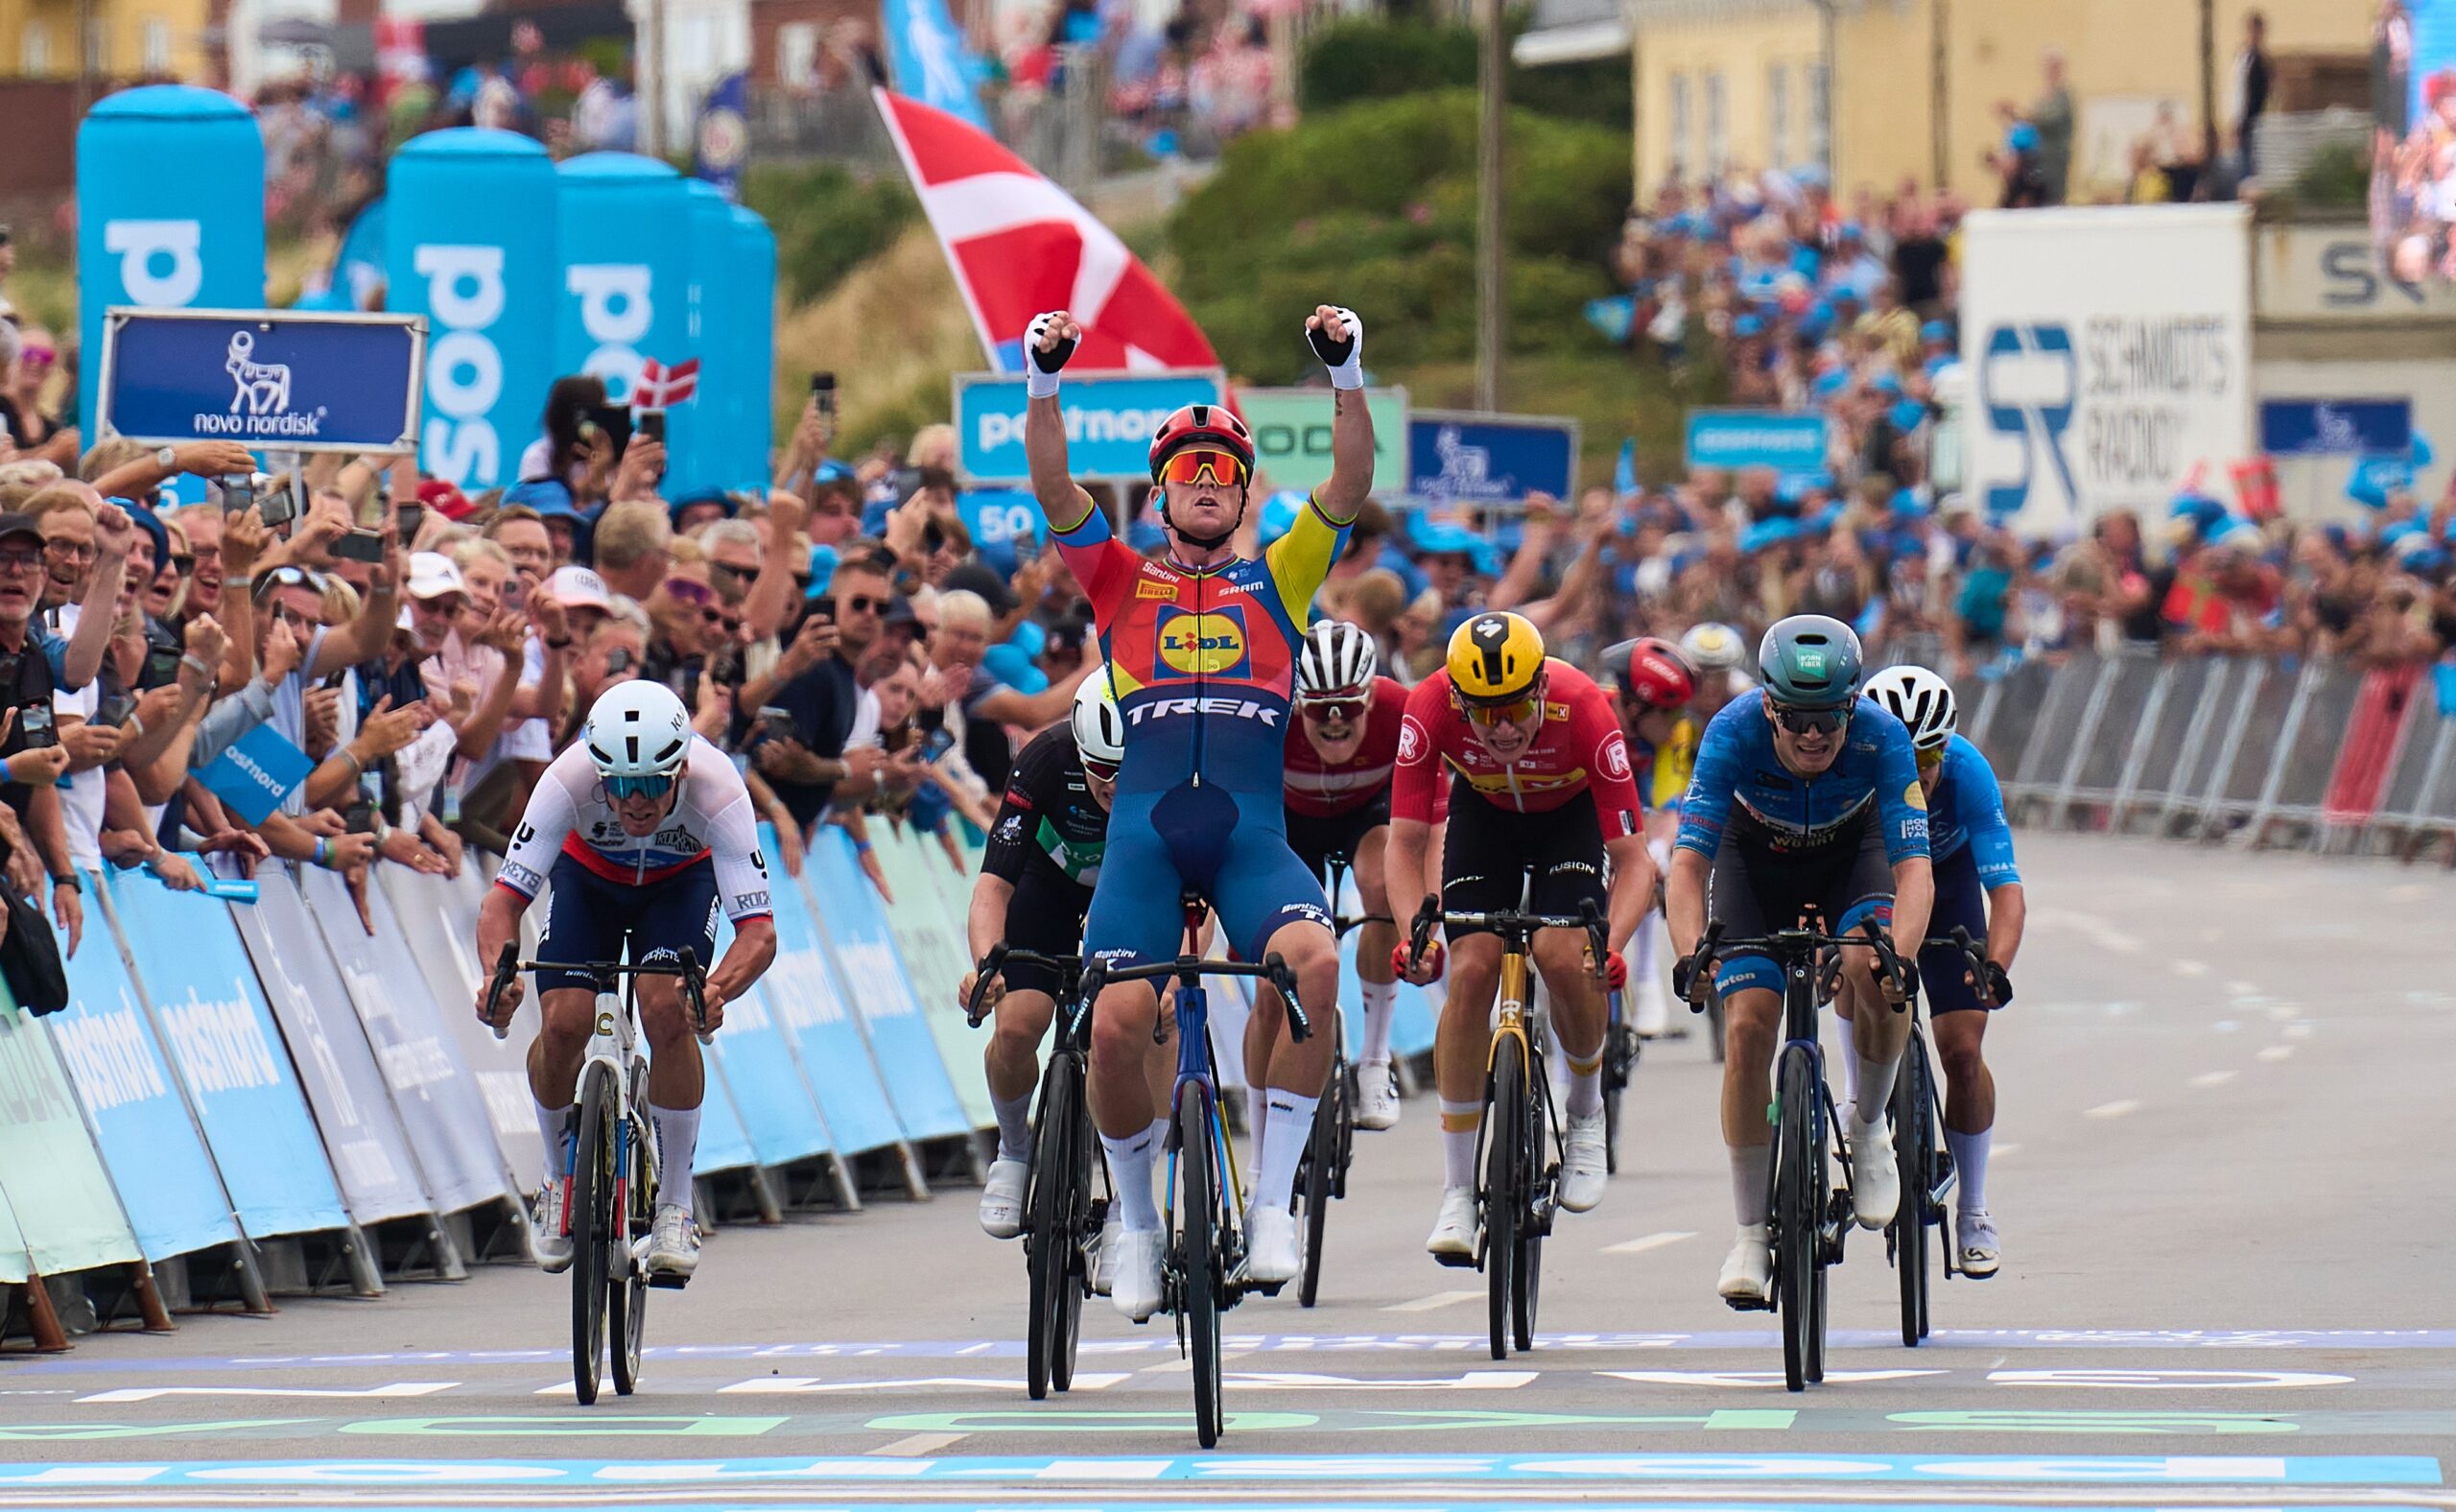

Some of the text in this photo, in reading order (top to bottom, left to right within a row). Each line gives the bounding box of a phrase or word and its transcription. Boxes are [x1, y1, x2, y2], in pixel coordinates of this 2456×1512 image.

[194, 412, 319, 436] novo nordisk
[978, 505, 1035, 544] 50
[1142, 561, 1181, 583] Santini
[1217, 580, 1264, 598] SRAM
[1126, 697, 1281, 727] TREK
[1605, 740, 1631, 775] R
[1548, 861, 1596, 876] FUSION
[1281, 902, 1324, 914] Santini
[1094, 948, 1137, 960] Santini
[161, 976, 280, 1116] postnord
[52, 983, 167, 1136] postnord
